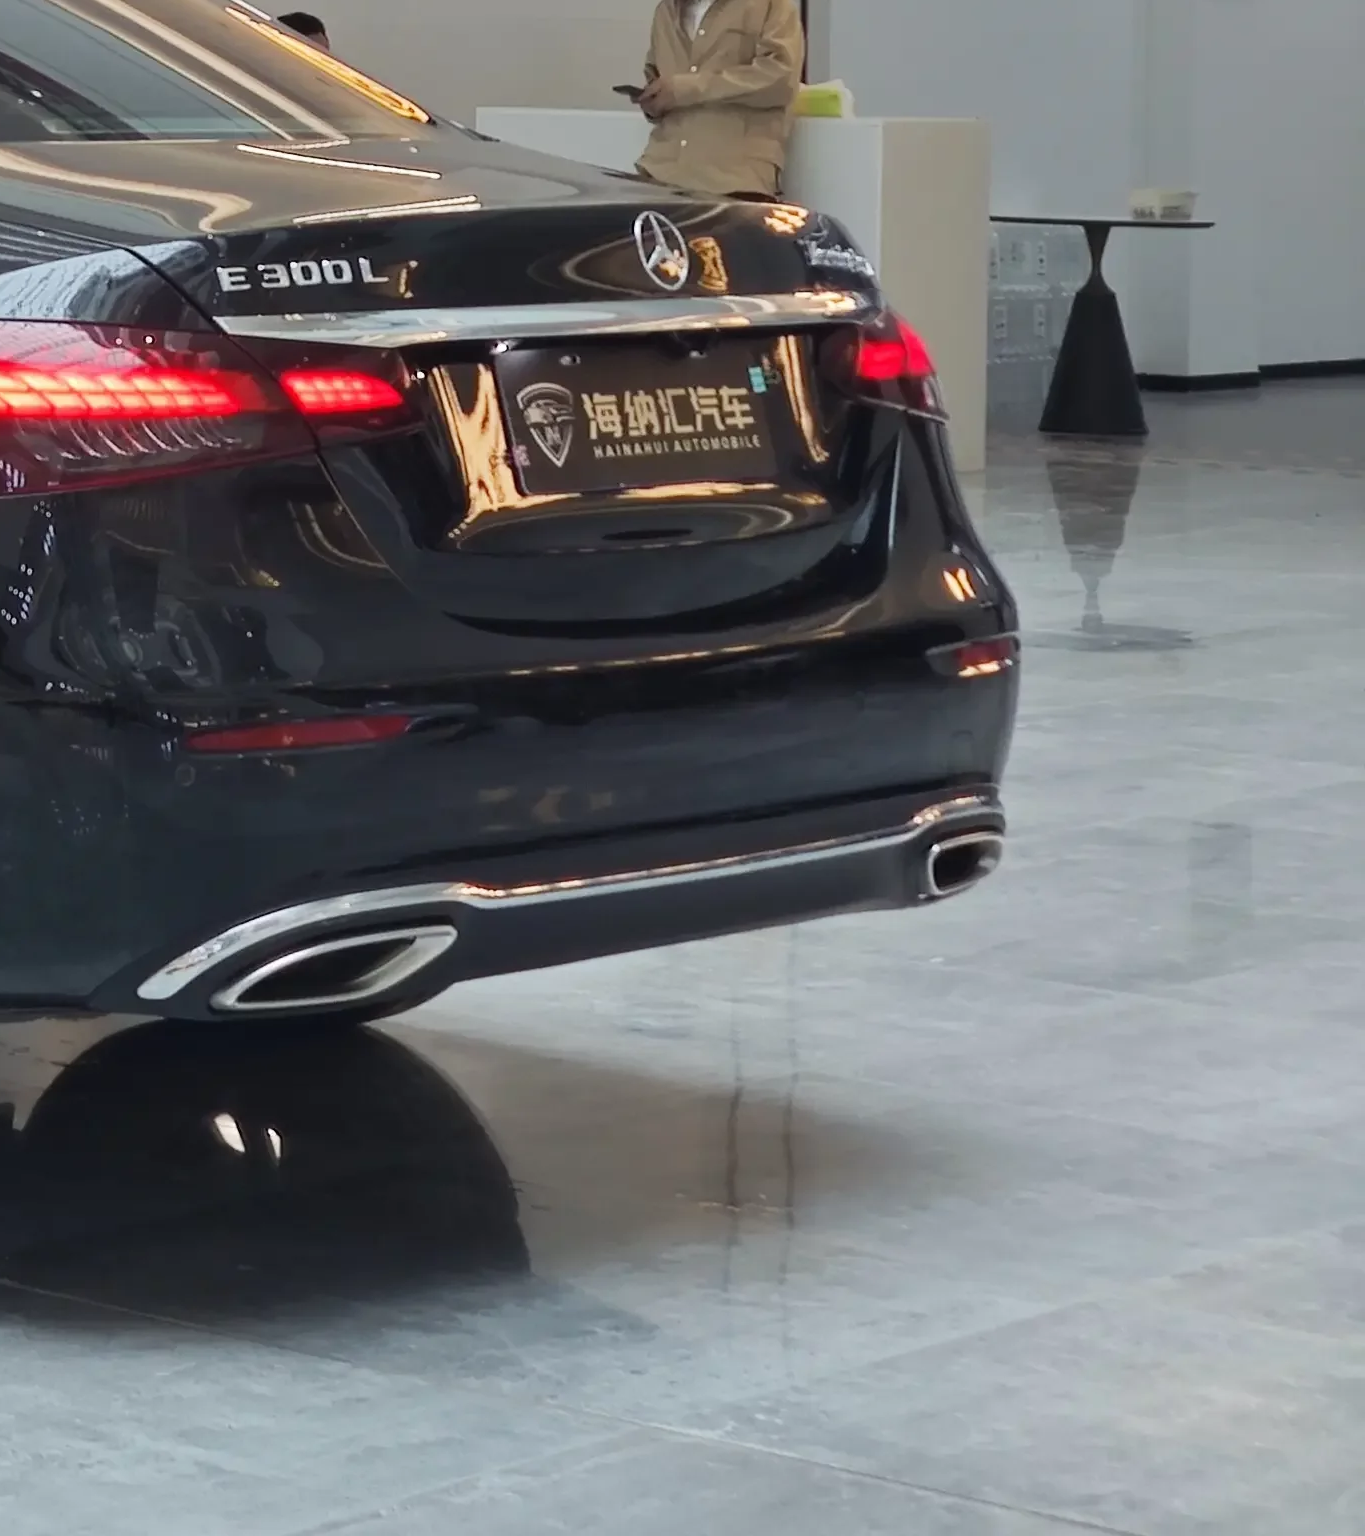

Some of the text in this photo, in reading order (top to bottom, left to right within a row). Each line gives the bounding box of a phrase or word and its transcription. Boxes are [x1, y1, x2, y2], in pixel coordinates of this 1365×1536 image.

[217, 257, 390, 292] E 300 L
[581, 385, 755, 440] 海纳汇汽车
[593, 434, 761, 459] HAINAHUI AUTOMOBILE
